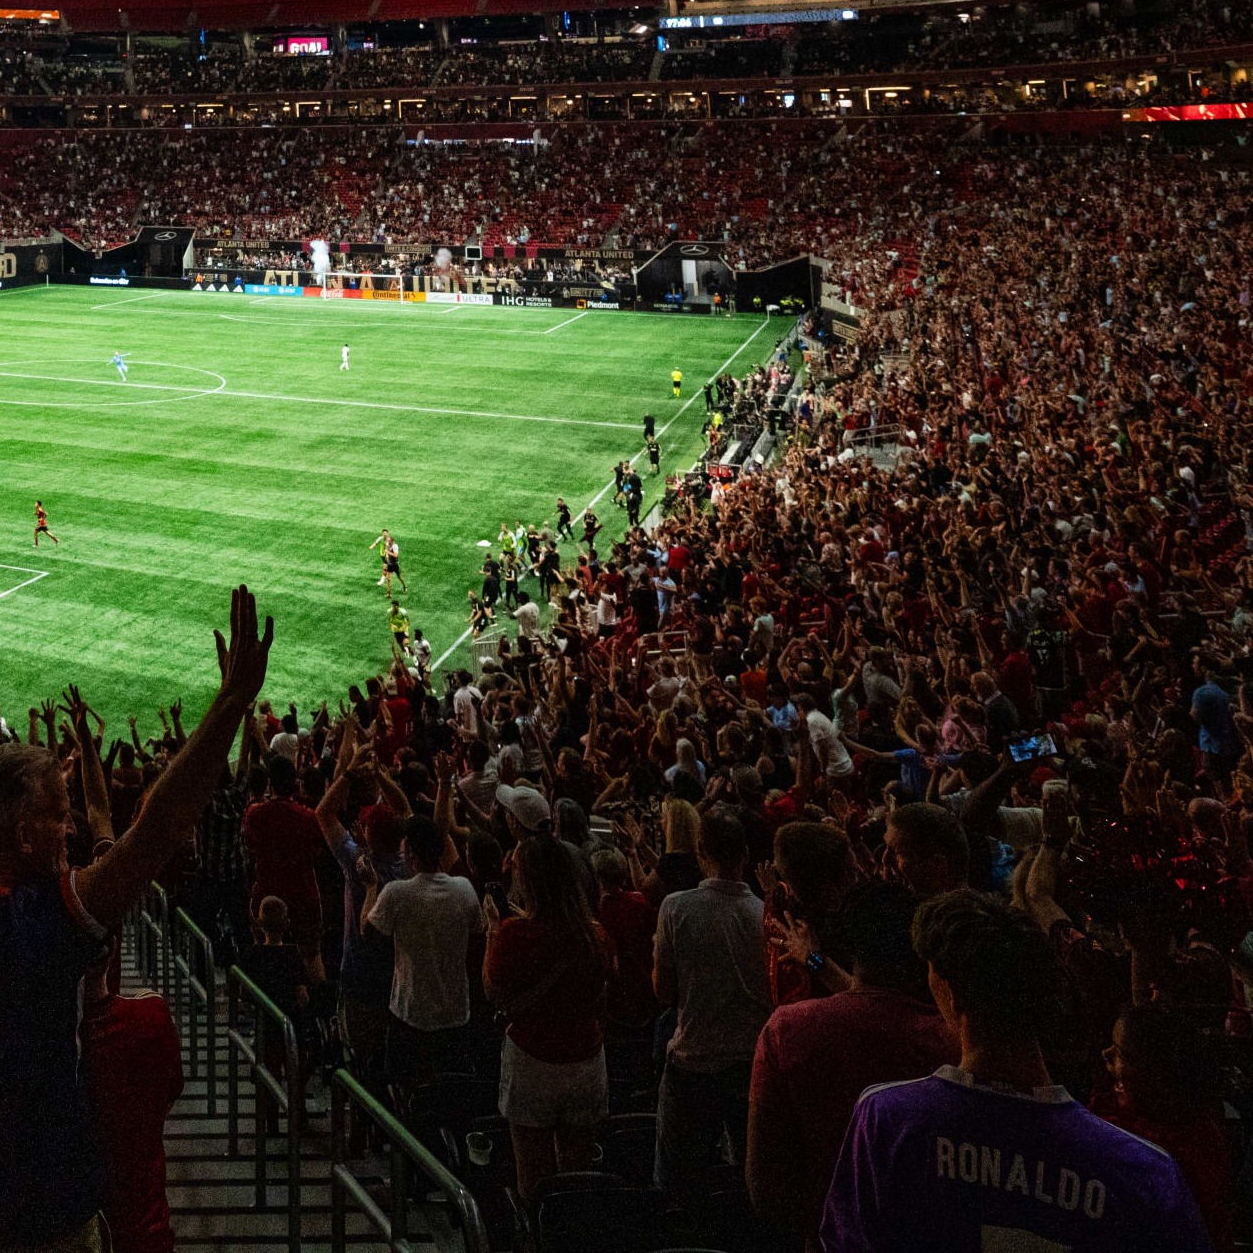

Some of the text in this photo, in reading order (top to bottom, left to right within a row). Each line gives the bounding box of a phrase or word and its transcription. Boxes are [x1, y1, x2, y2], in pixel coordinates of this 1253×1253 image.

[565, 249, 635, 259] ATLANTA UNITED
[501, 296, 525, 306] IHG
[587, 300, 620, 310] Piedmont
[935, 1136, 1107, 1220] RONALDO
